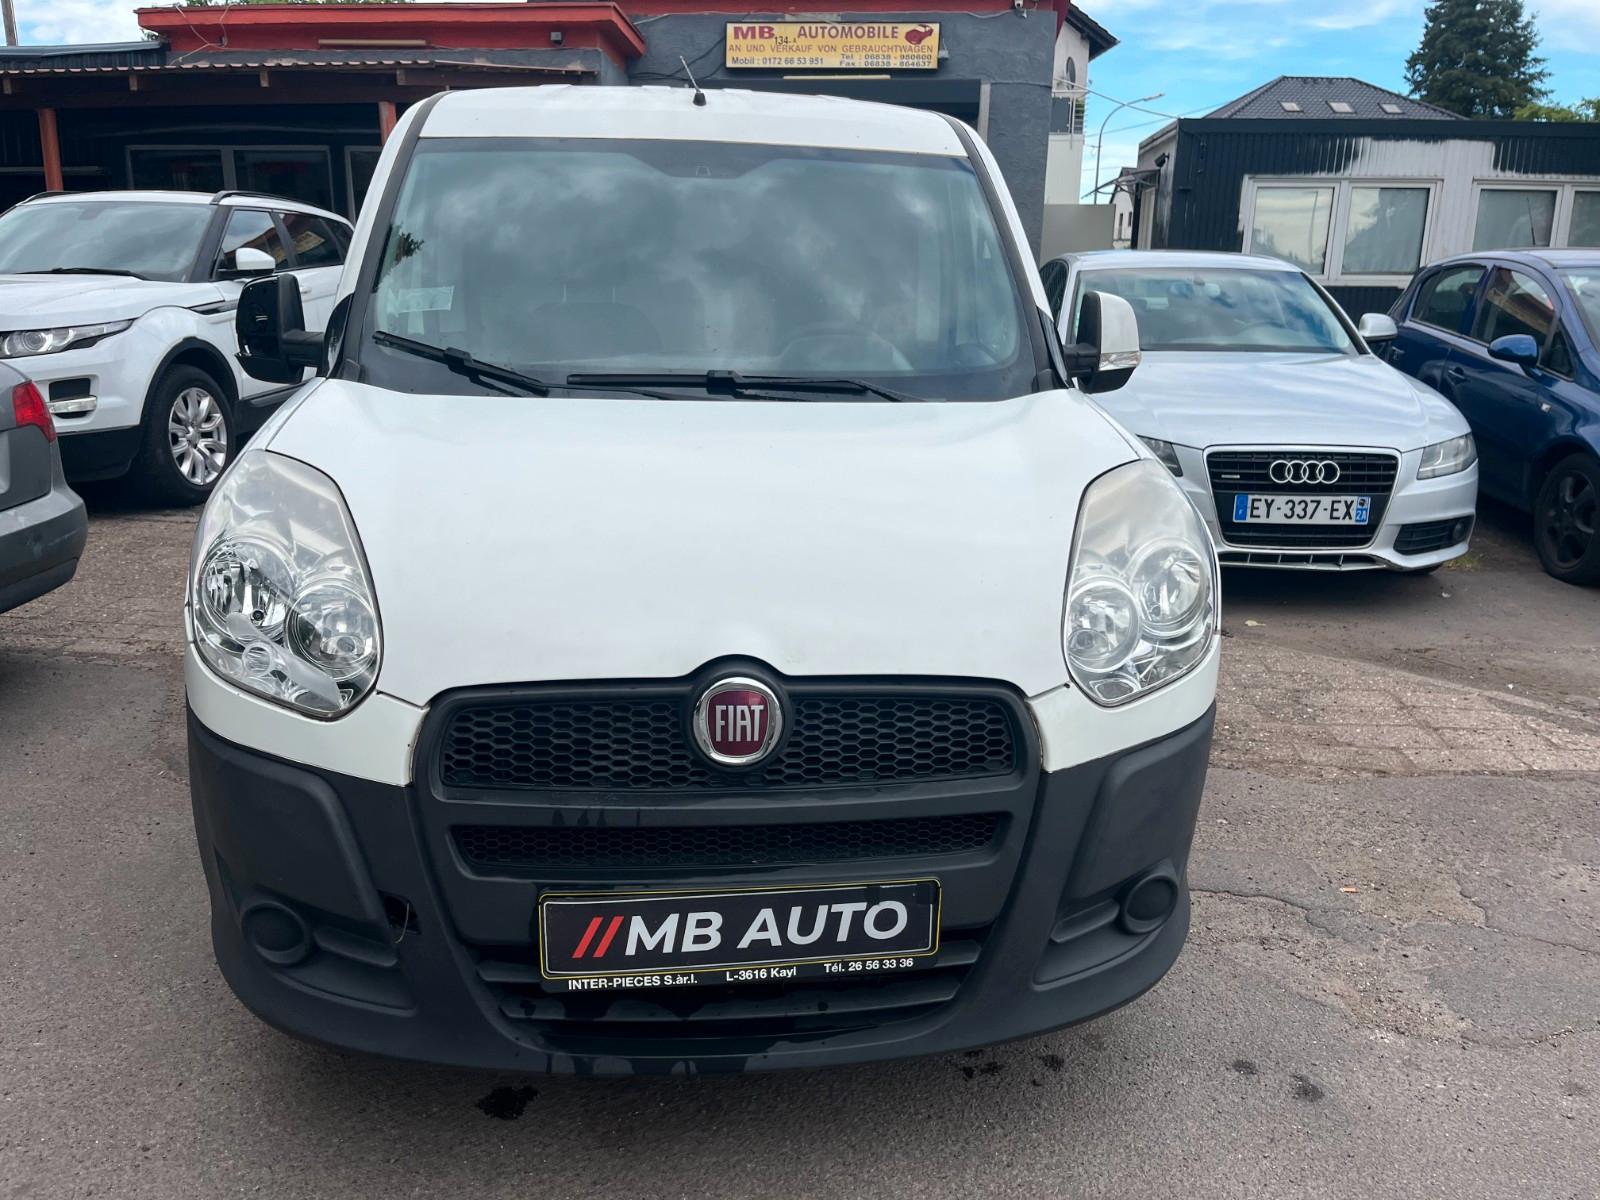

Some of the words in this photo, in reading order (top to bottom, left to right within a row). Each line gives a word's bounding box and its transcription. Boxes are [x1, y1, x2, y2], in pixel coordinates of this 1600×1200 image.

[733, 26, 775, 40] MB
[797, 25, 899, 39] AUTOMOBILE
[729, 44, 742, 52] AN
[746, 44, 766, 53] UND
[771, 44, 813, 53] VERKAUF
[817, 44, 837, 53] VON
[842, 44, 933, 53] GEBRAUCHTWAGEN
[732, 56, 755, 65] Mobil
[762, 57, 782, 65] 0172
[796, 57, 807, 65] 53
[809, 57, 824, 65] 951
[1250, 498, 1355, 521] EY-337-EX
[1356, 509, 1367, 521] 2A
[715, 704, 764, 742] FIAT
[736, 900, 908, 949] AUTO
[824, 962, 845, 974] Tél.
[848, 961, 863, 972] 26
[865, 960, 880, 970] 56
[882, 959, 897, 969] 33
[899, 957, 914, 968] 36
[568, 976, 661, 990] INTER-PIECES
[664, 973, 698, 985] S.àr.l.
[726, 968, 768, 982] L-3616
[770, 966, 797, 979] Kayl
